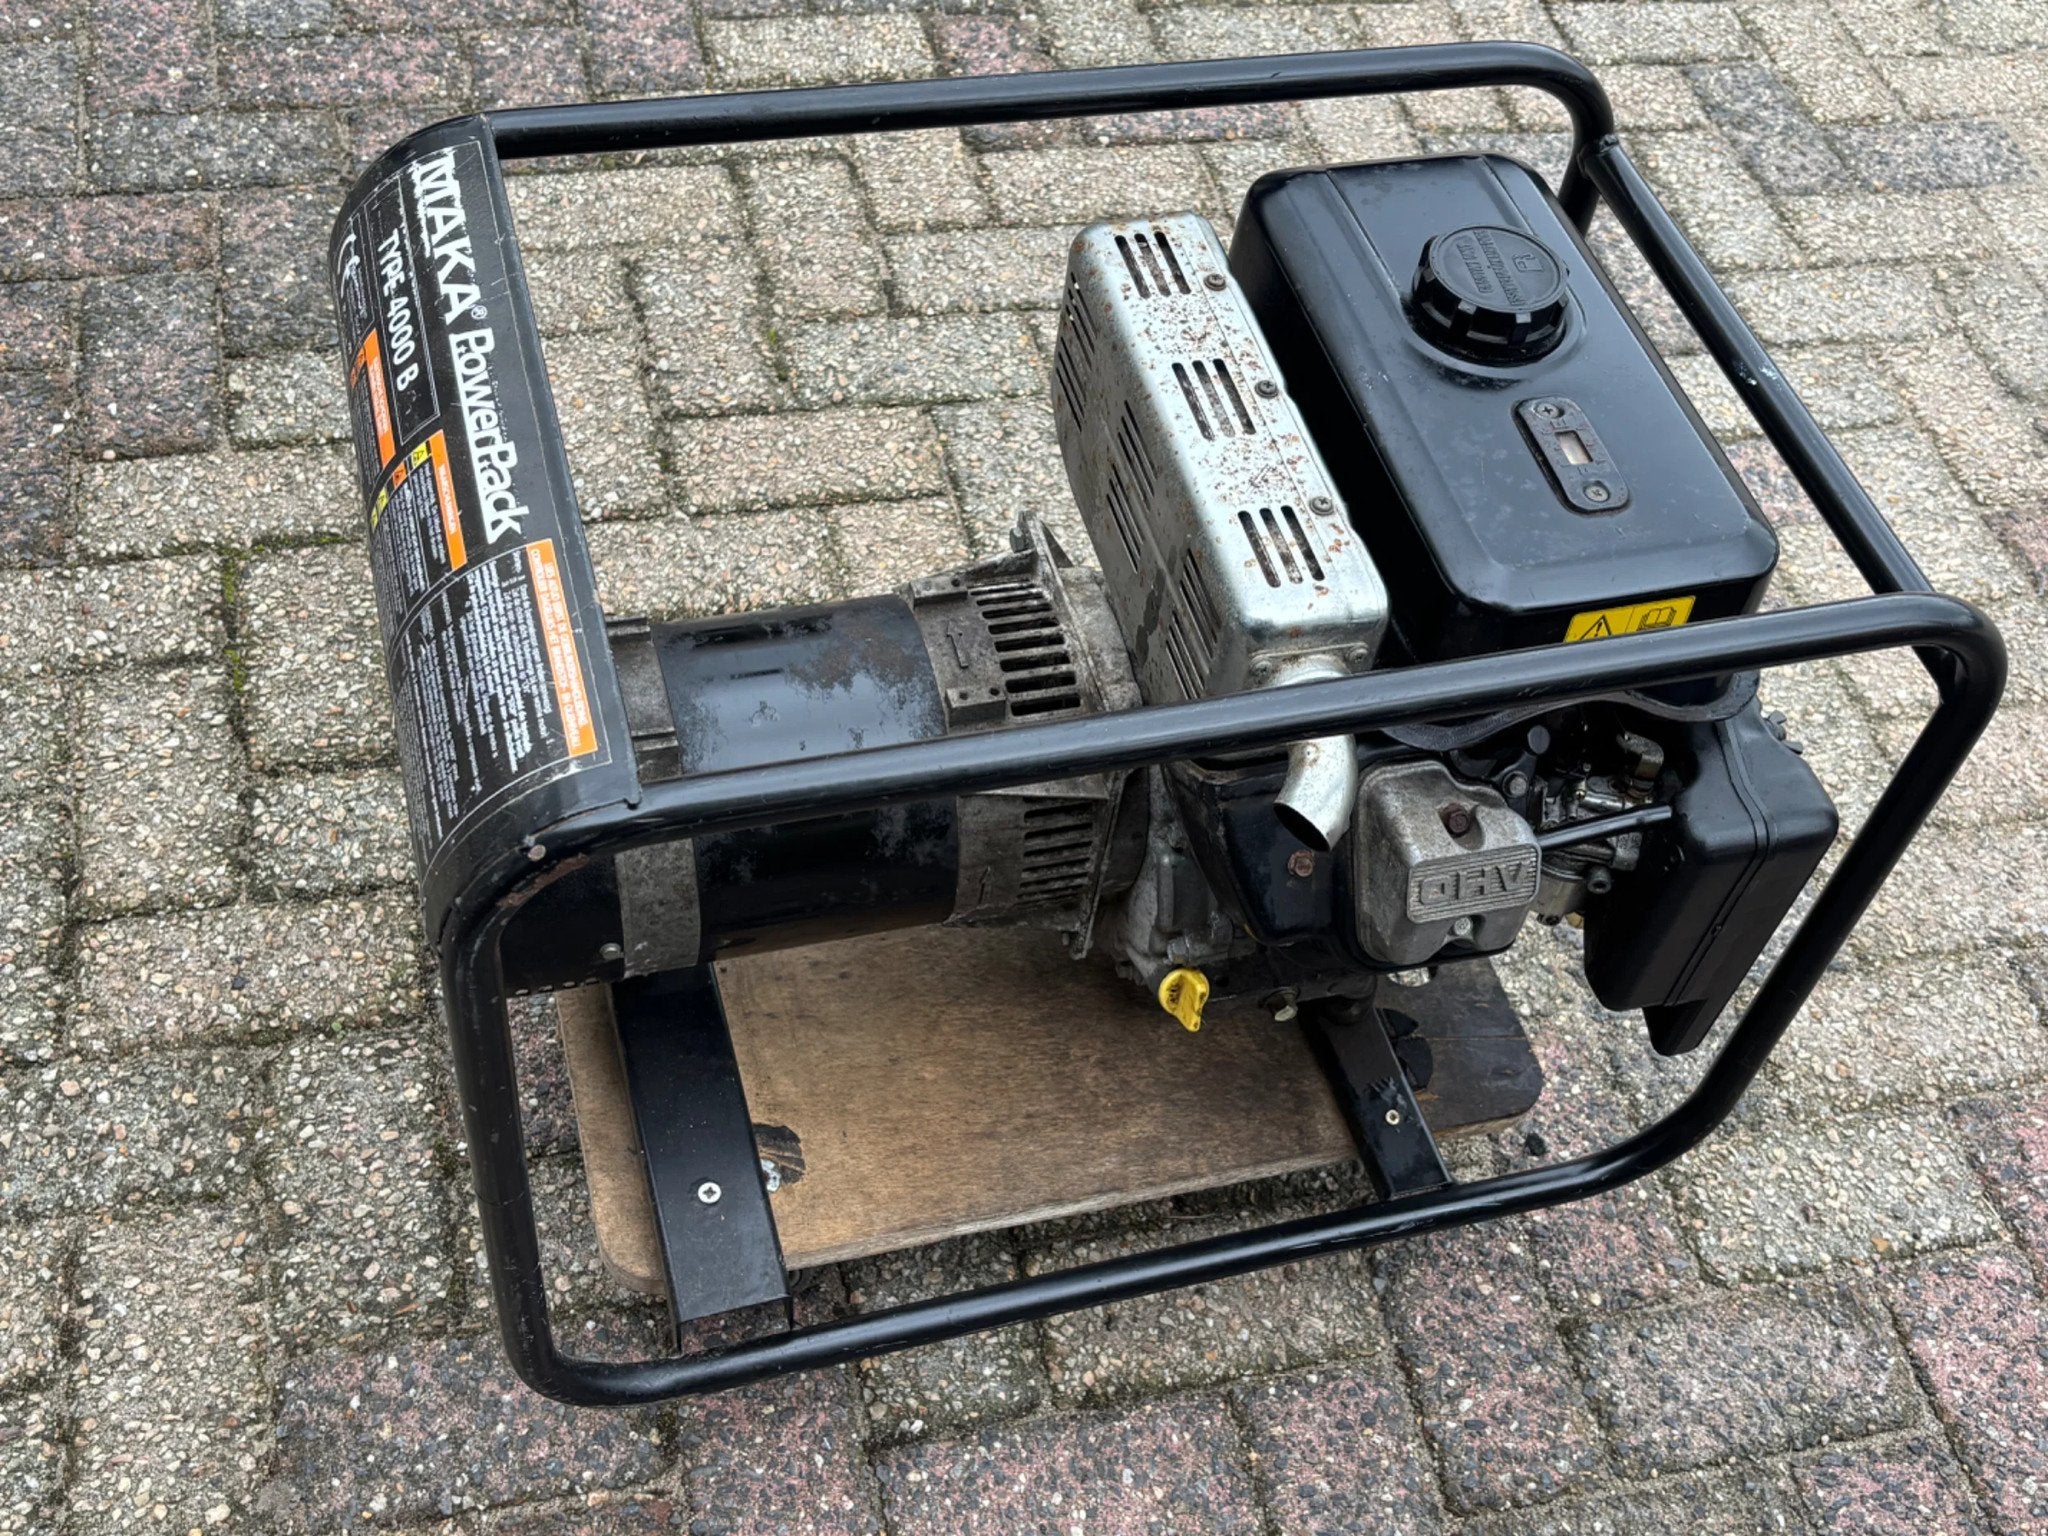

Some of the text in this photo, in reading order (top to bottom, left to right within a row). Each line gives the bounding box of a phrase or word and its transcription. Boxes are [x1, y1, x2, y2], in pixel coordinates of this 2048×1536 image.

[377, 228, 419, 391] TYPE 4000 B
[449, 327, 530, 545] PowerPack
[1419, 861, 1529, 906] OHV
